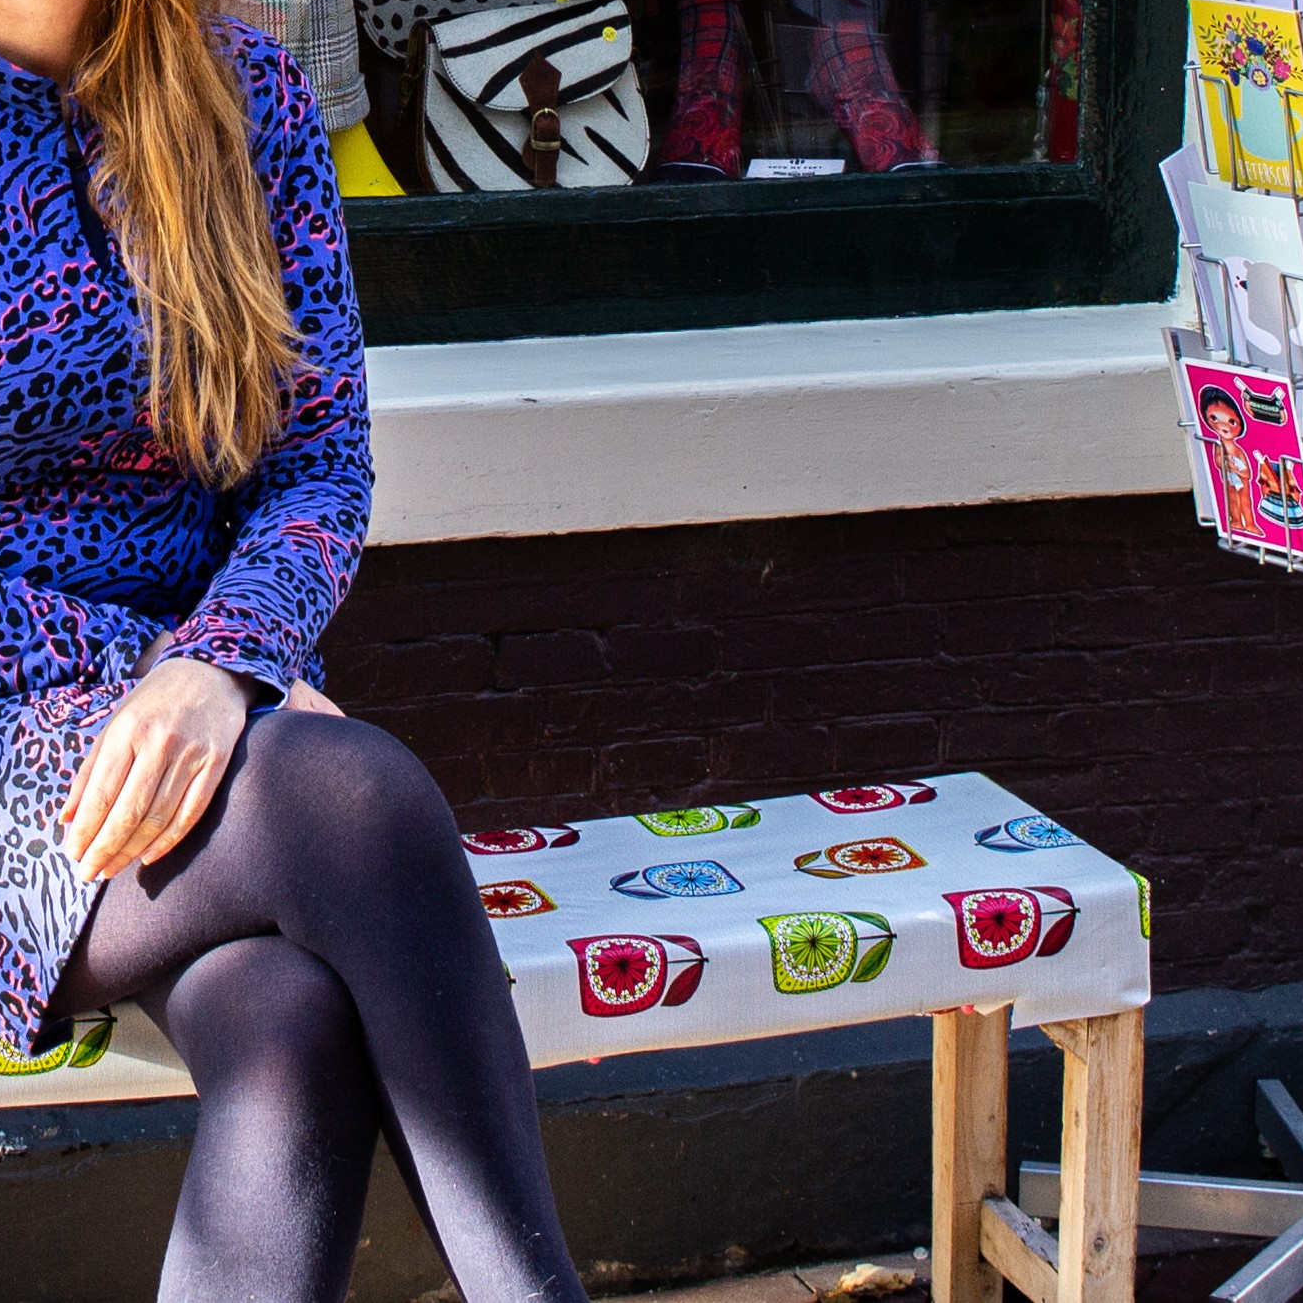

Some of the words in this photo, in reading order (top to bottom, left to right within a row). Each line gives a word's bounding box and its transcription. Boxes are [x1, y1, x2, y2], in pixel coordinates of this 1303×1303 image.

[1200, 207, 1223, 232] BIG
[1226, 212, 1258, 238] BEAR
[1261, 217, 1288, 242] HUG
